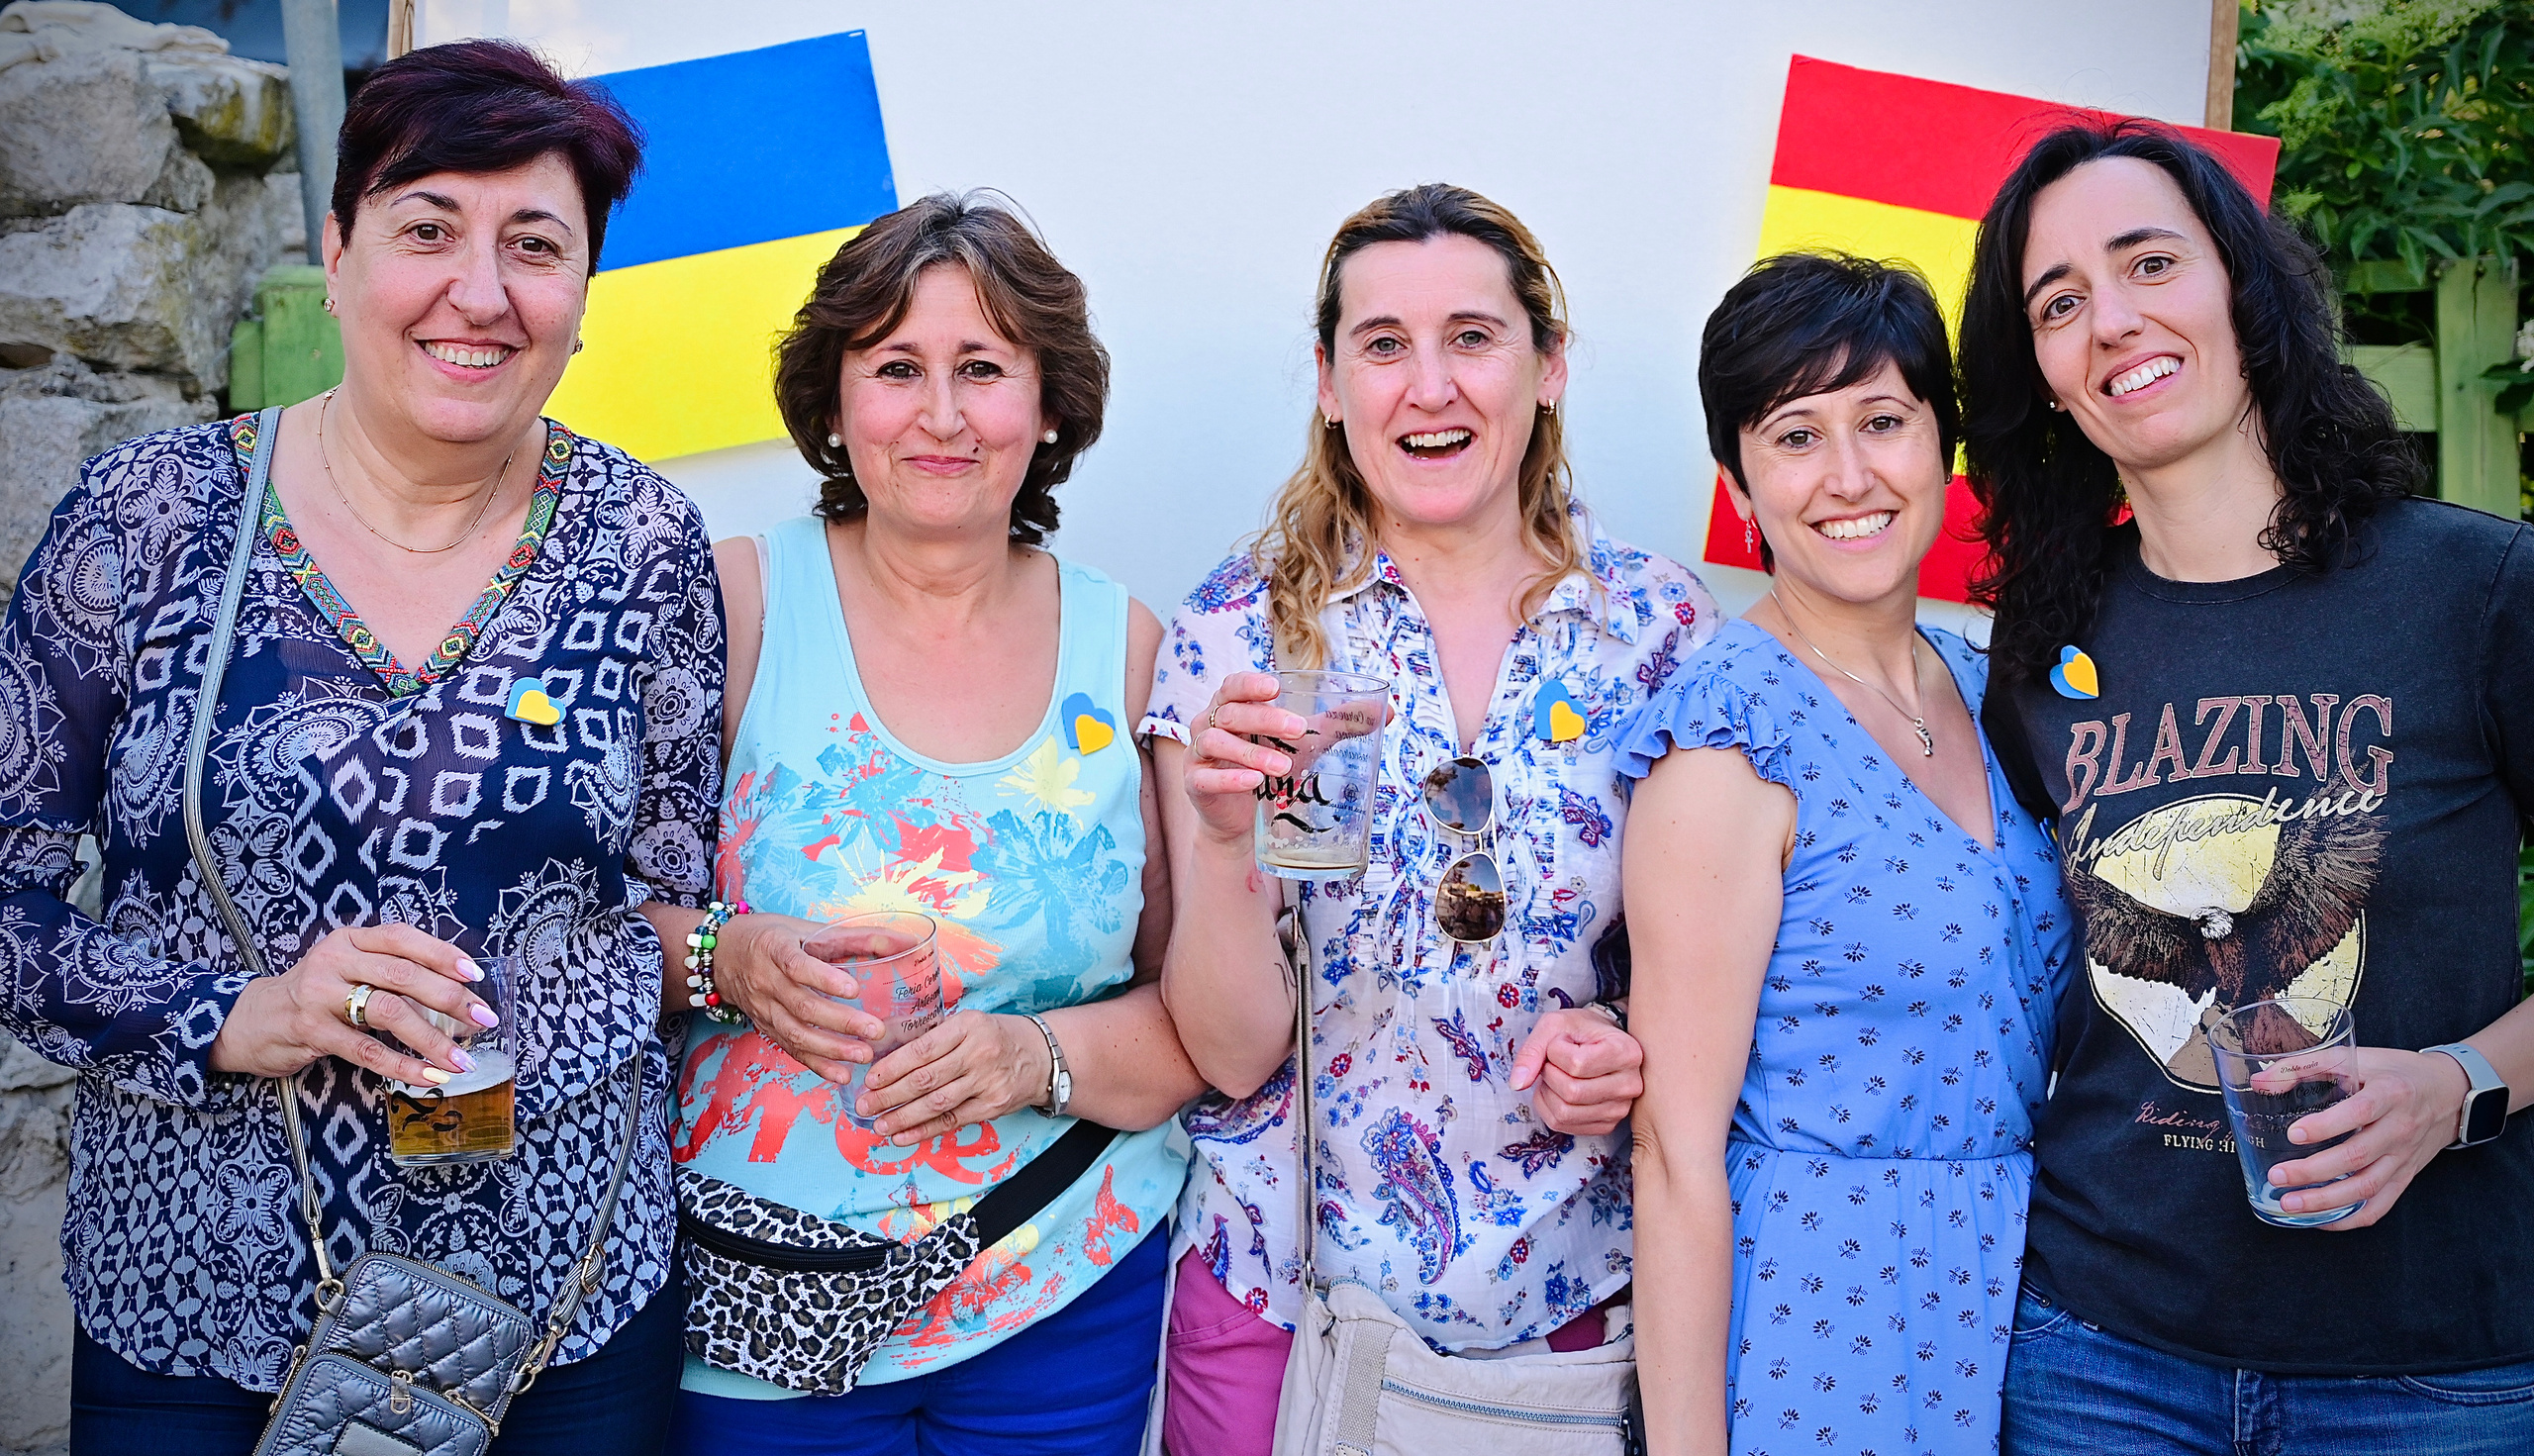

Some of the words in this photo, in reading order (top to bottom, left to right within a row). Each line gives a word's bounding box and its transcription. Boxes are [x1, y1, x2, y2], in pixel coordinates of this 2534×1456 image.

[2061, 693, 2394, 815] BLAZING
[2068, 786, 2387, 881] Independence
[895, 982, 923, 1000] Feria
[2135, 1100, 2223, 1145] Riding
[2163, 1133, 2214, 1151] FLYING
